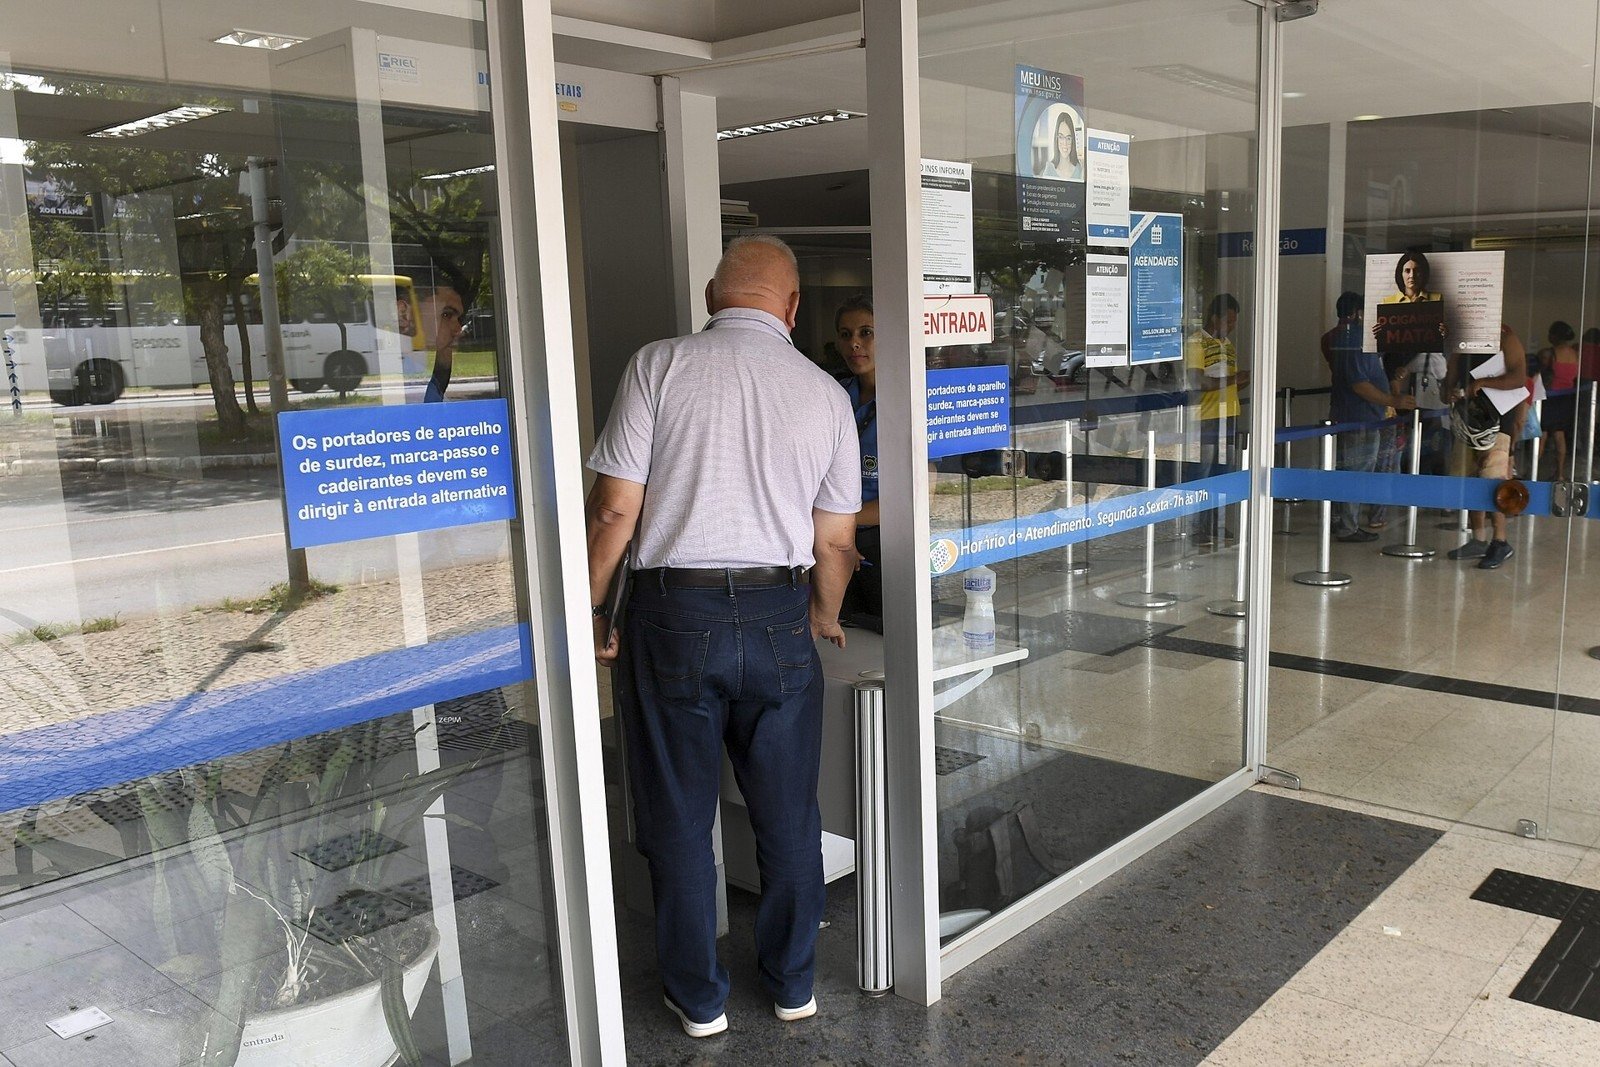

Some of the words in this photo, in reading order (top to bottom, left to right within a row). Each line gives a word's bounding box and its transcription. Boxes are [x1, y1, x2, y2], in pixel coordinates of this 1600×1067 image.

[1020, 70, 1040, 86] MEU
[1042, 74, 1061, 90] INSS
[1097, 142, 1120, 152] ATENÇÃO
[925, 164, 938, 173] INSS
[940, 167, 965, 176] INFORMA
[1096, 265, 1118, 275] ATENÇÃO
[924, 311, 987, 334] ENTRADA
[928, 384, 966, 398] portadores
[967, 383, 976, 392] de
[978, 381, 1006, 393] aparelho
[928, 400, 954, 411] surdez,
[956, 397, 999, 408] marca-passo
[967, 412, 989, 421] devem
[292, 435, 317, 450] Os
[322, 429, 411, 451] portadores
[415, 426, 434, 441] de
[438, 421, 502, 441] aparelho
[939, 430, 944, 439] à
[945, 427, 971, 439] entrada
[973, 423, 1007, 435] alternativa
[299, 458, 320, 473] de
[325, 453, 386, 471] surdez,
[390, 445, 486, 464] marca-passo
[491, 443, 499, 454] e
[318, 473, 413, 494] cadeirantes
[417, 469, 467, 484] devem
[470, 466, 488, 478] se
[298, 501, 349, 520] dirigir
[353, 499, 364, 514] à
[368, 492, 427, 512] entrada
[431, 483, 507, 504] alternativa
[1024, 517, 1095, 542] Atendimento.
[1097, 505, 1137, 527] Segunda
[1139, 505, 1144, 515] a
[1185, 493, 1193, 505] às
[1195, 489, 1208, 503] 17h
[242, 1032, 284, 1048] entrada
